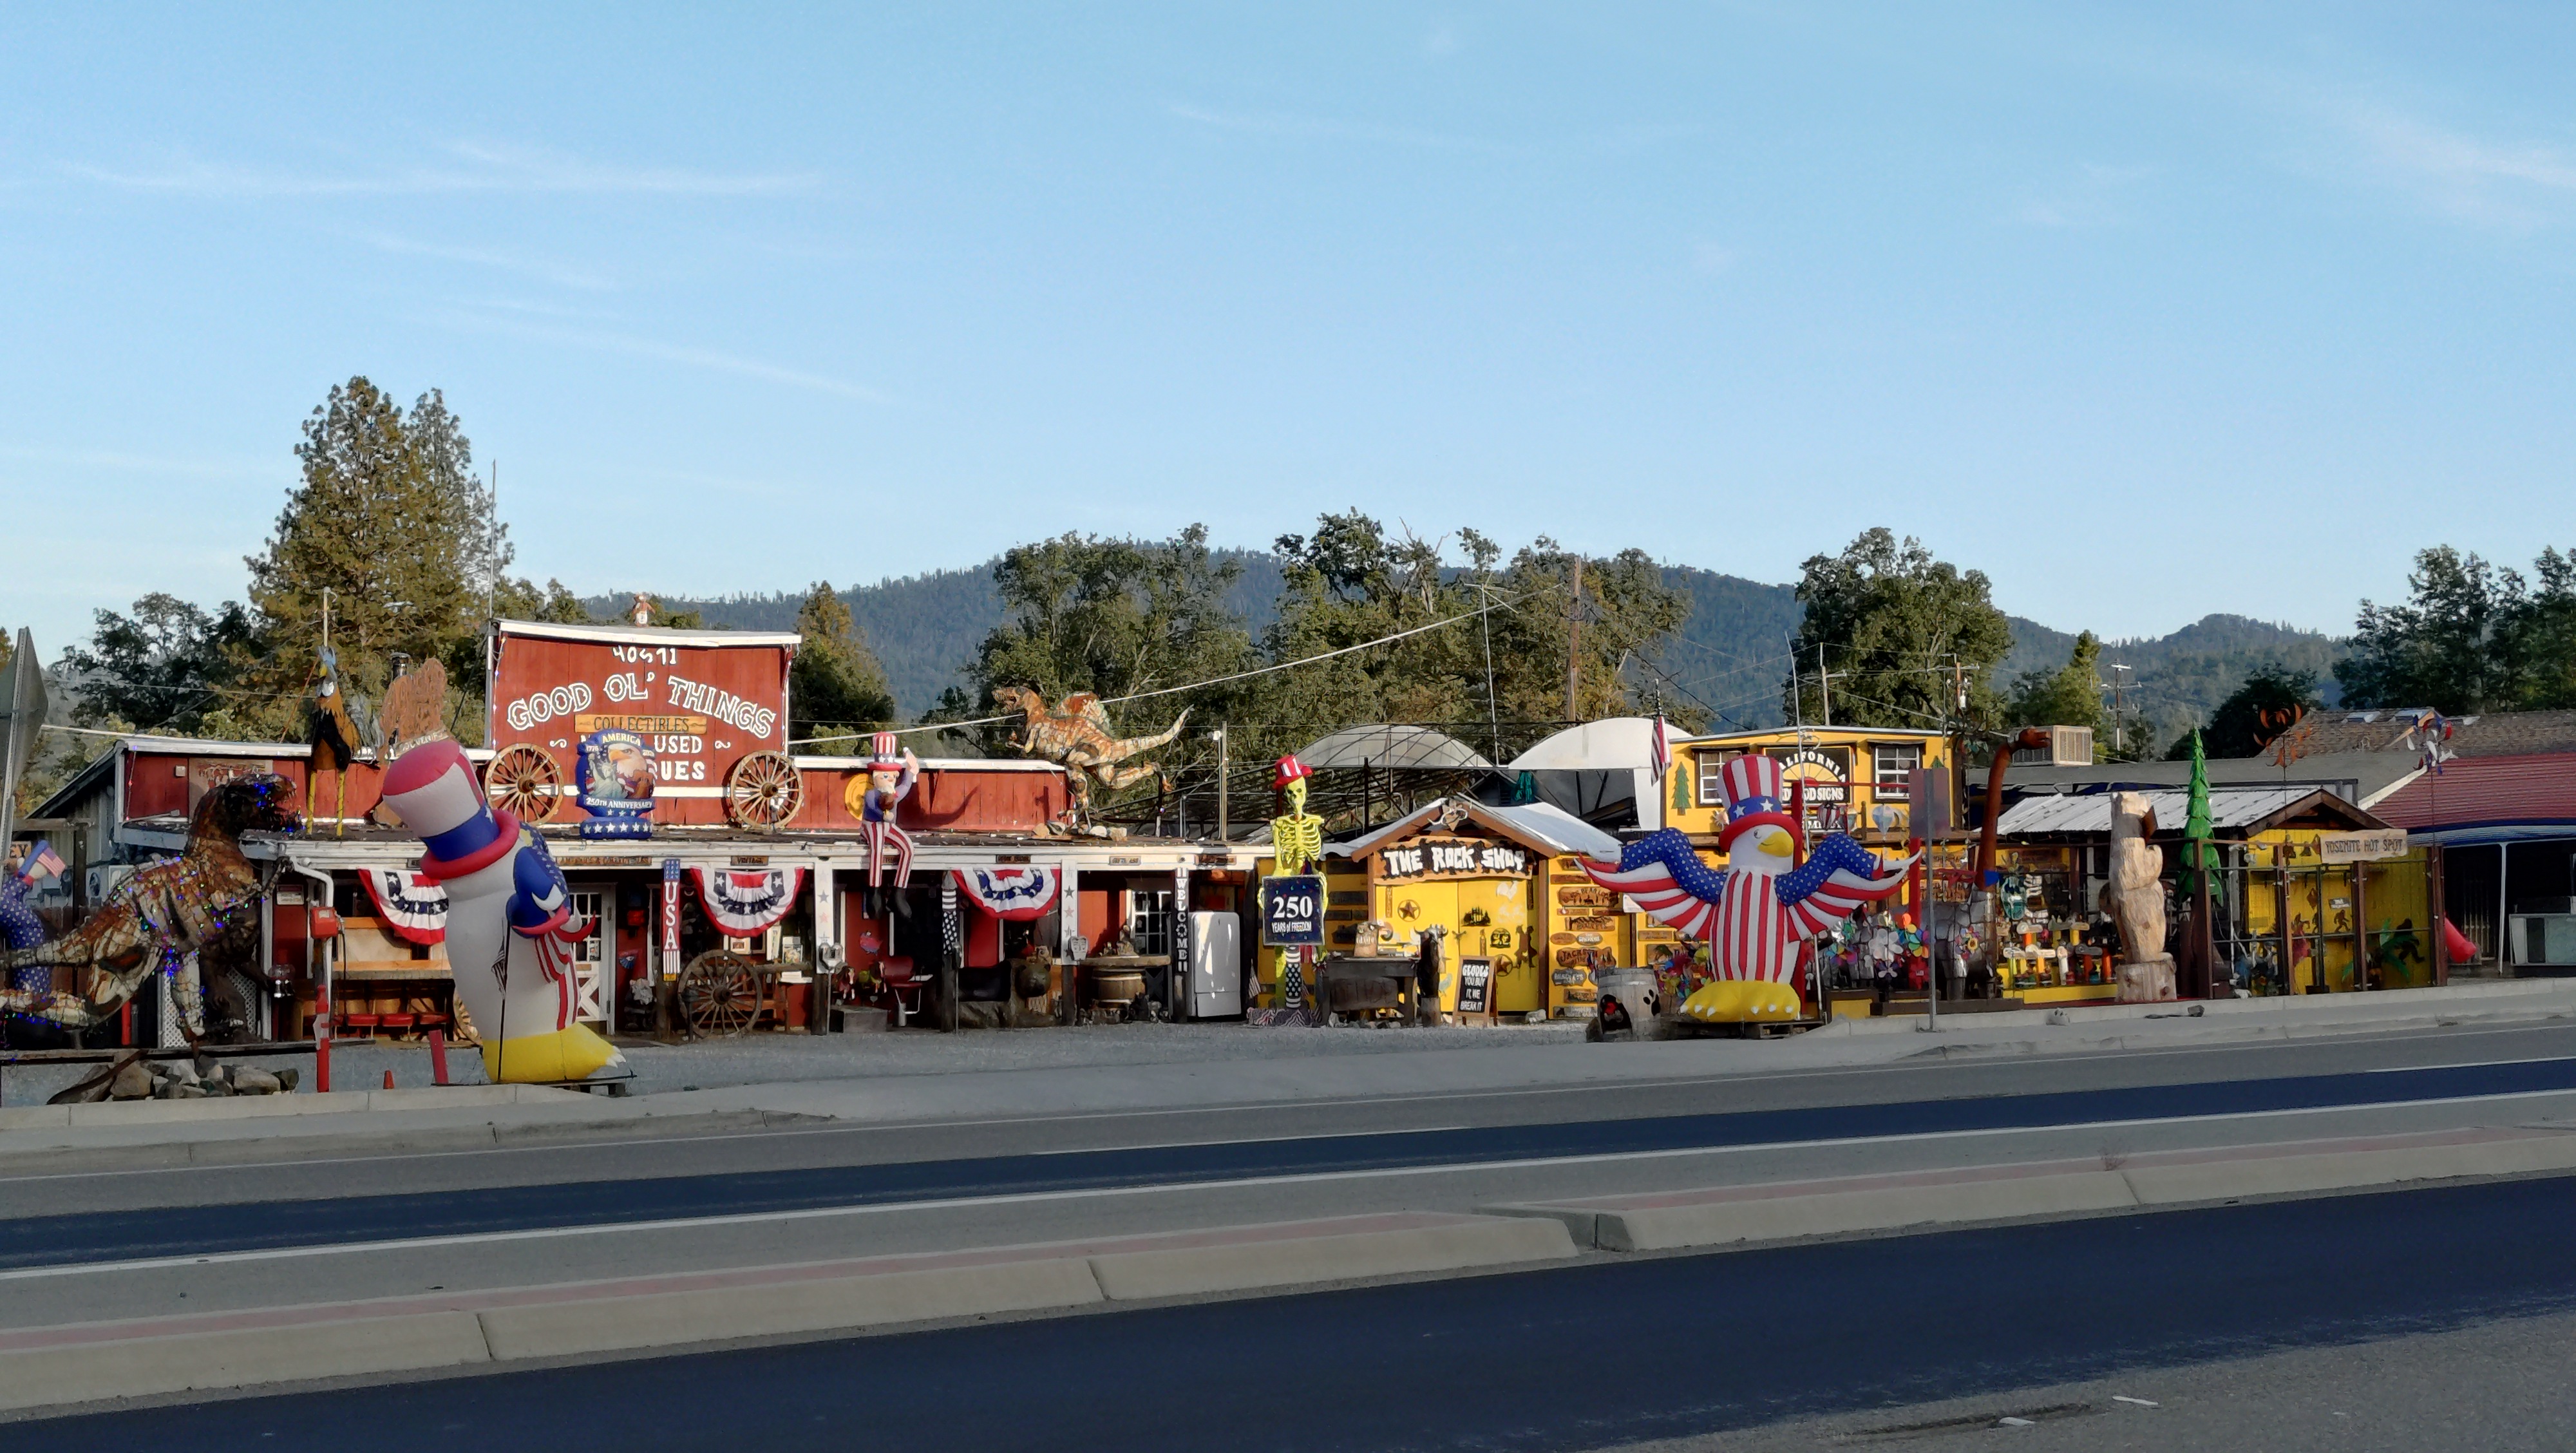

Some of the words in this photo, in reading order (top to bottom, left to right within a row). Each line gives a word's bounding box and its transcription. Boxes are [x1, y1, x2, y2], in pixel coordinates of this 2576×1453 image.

[507, 683, 591, 731] GOOD
[603, 672, 655, 702] OL'
[668, 675, 777, 739] THINGS
[594, 716, 689, 732] COLLECTIBLES
[601, 733, 641, 746] AMERICA
[654, 734, 703, 754] USED
[1778, 751, 1846, 783] ALIFORNIA
[1817, 787, 1844, 801] SIGNS
[585, 796, 607, 806] 250TH
[608, 800, 653, 809] ANNIVERSARY
[2325, 839, 2360, 853] YOSEMITE
[2363, 839, 2380, 851] HOT
[2383, 839, 2403, 851] SPOT
[1384, 848, 1423, 876] THE
[1430, 845, 1476, 872] ROCK
[1481, 847, 1526, 871] SHOP
[1272, 895, 1313, 919] 250
[664, 881, 678, 950] USA
[1175, 878, 1188, 960] WELCOME
[1271, 921, 1286, 934] YEARS
[1291, 921, 1312, 933] FREEDOM
[1464, 976, 1475, 986] YOU
[1475, 976, 1486, 987] BUY
[1472, 988, 1481, 1000] WE
[1460, 1000, 1477, 1011] BREAK
[1477, 1002, 1483, 1012] IT
